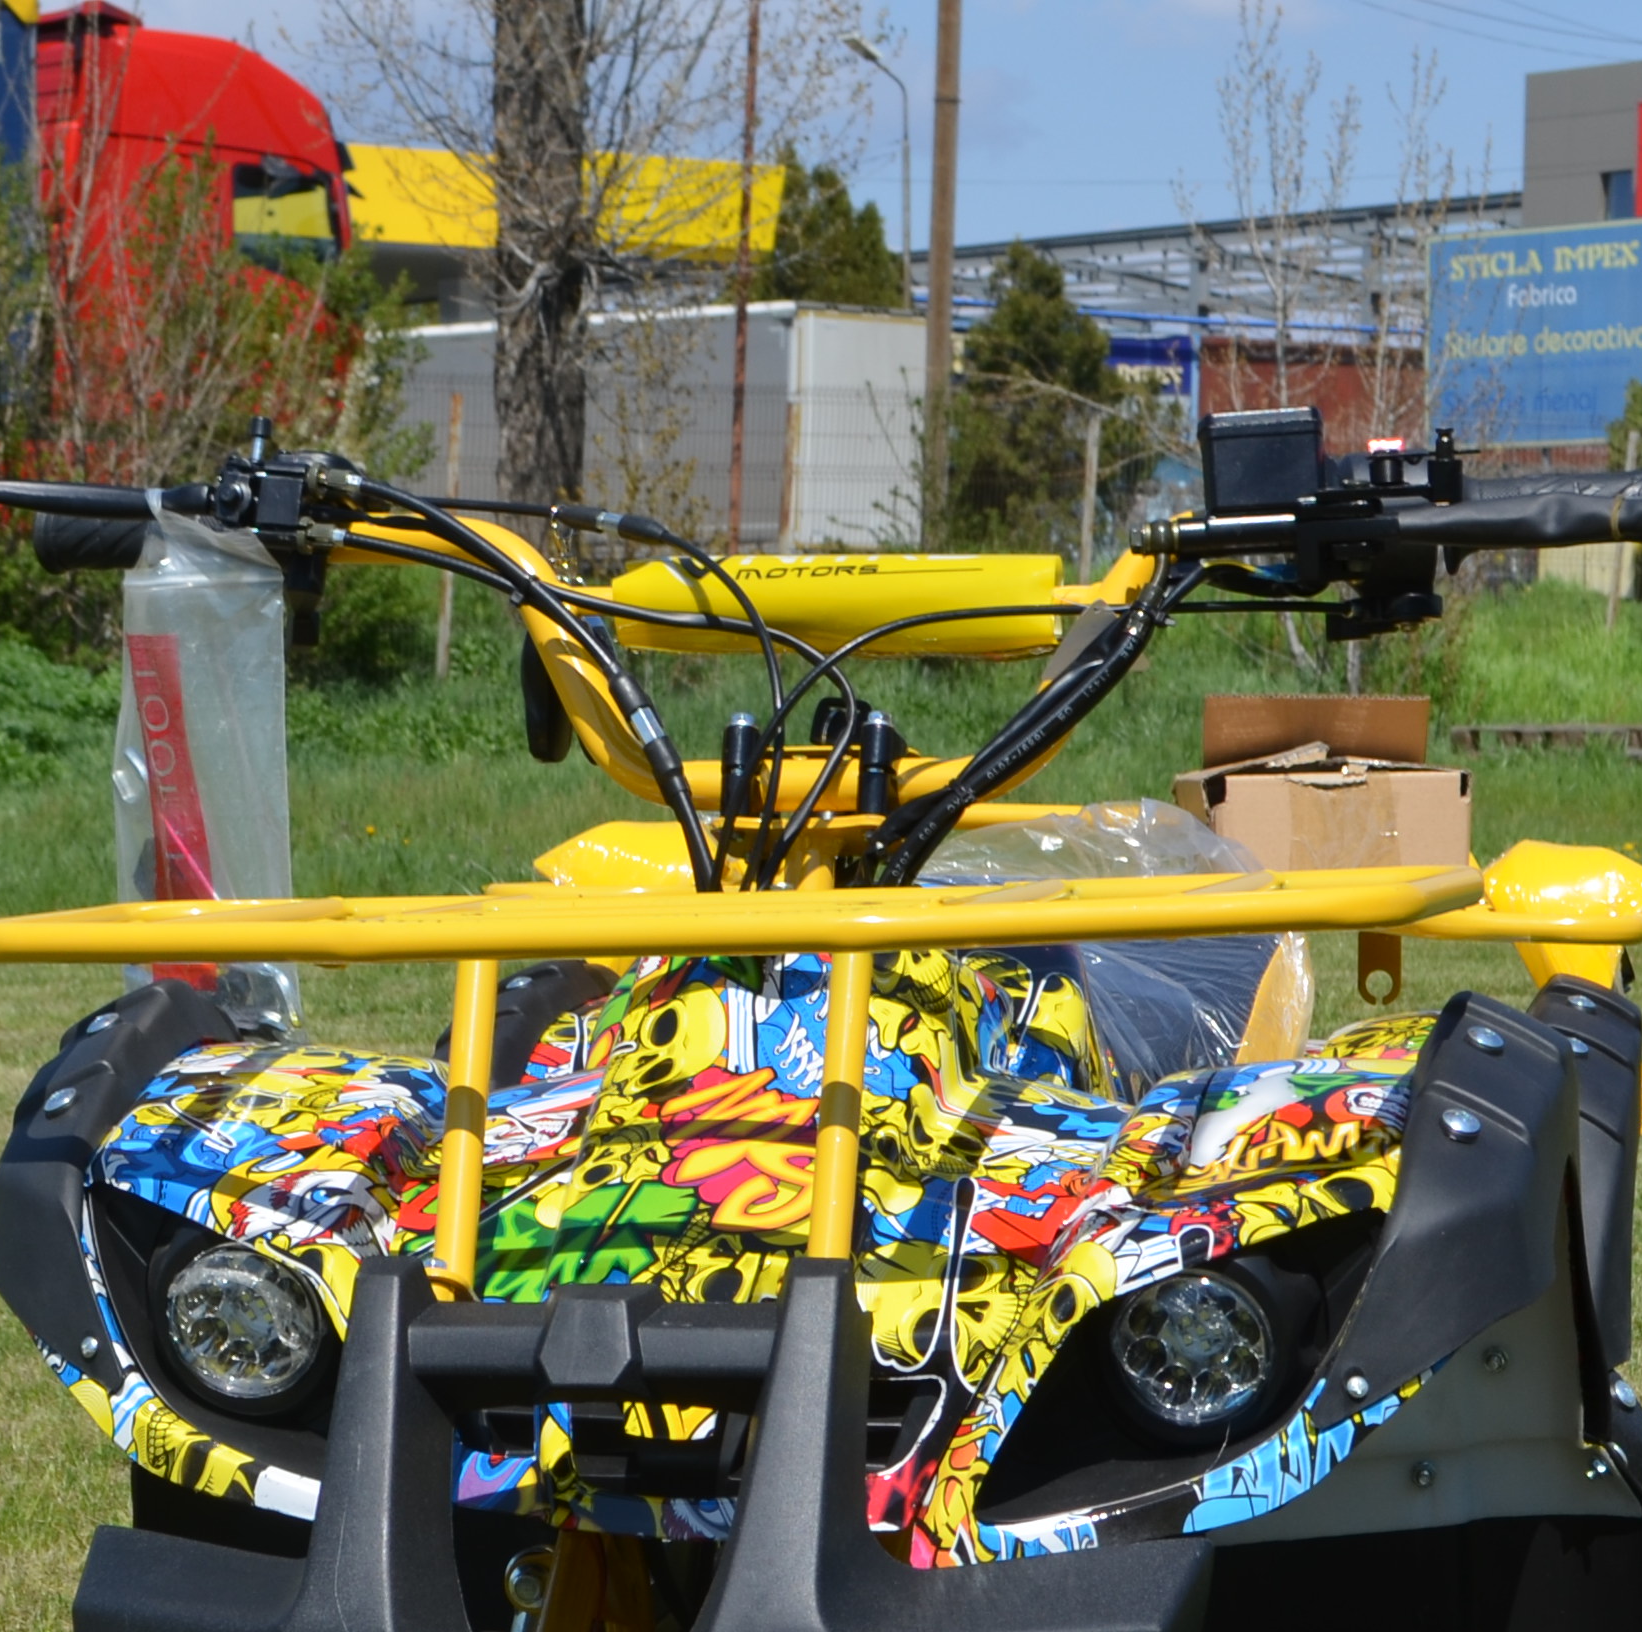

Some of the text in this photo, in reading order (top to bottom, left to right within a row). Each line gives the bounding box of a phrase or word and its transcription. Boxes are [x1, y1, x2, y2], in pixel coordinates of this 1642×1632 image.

[1450, 241, 1641, 282] STICLA IMPEX
[1507, 282, 1578, 308] Fabrica
[735, 564, 879, 580] MOTORS
